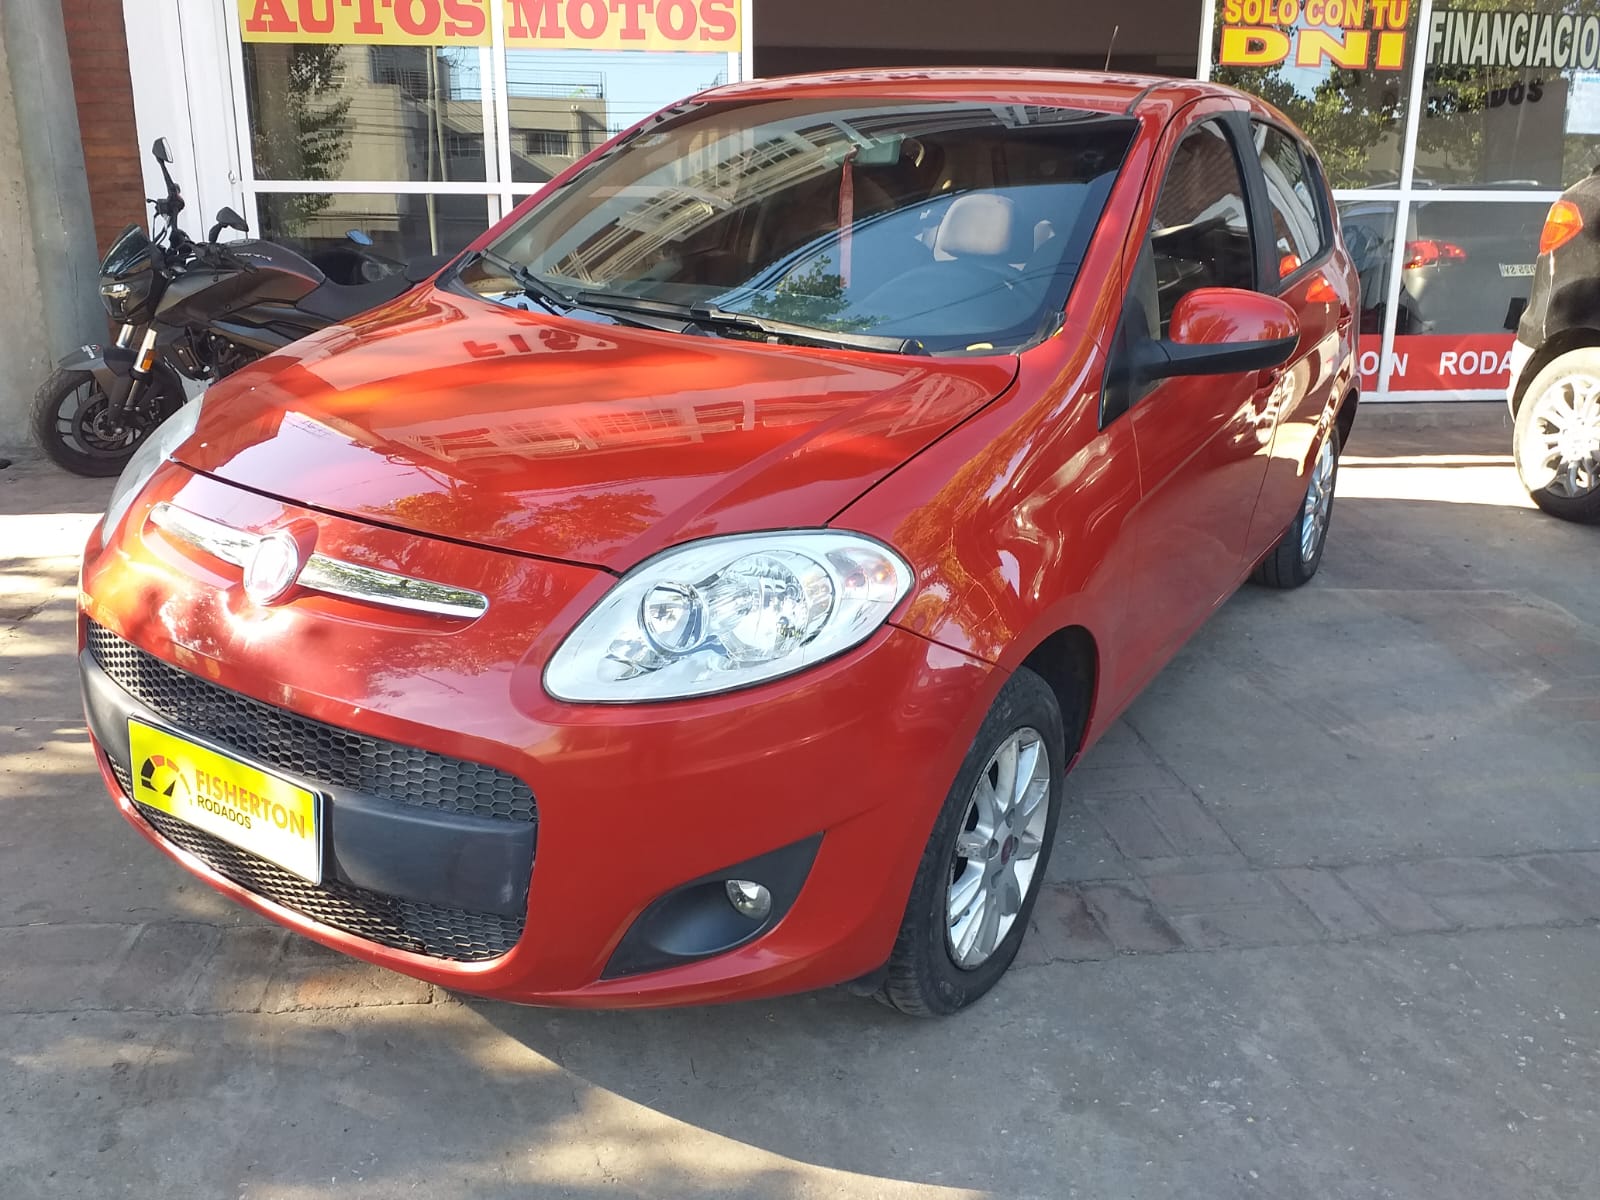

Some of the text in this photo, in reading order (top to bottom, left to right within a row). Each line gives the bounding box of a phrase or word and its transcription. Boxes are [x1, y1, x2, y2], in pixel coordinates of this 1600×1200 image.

[245, 0, 485, 37] AUTOS
[508, 0, 737, 41] MOTOS
[1223, 0, 1410, 30] SOLO CON TU
[1219, 25, 1407, 70] DNI
[1426, 10, 1600, 69] FINANCIACIO
[195, 768, 305, 838] FISHERTON
[197, 794, 252, 830] RODADOS
